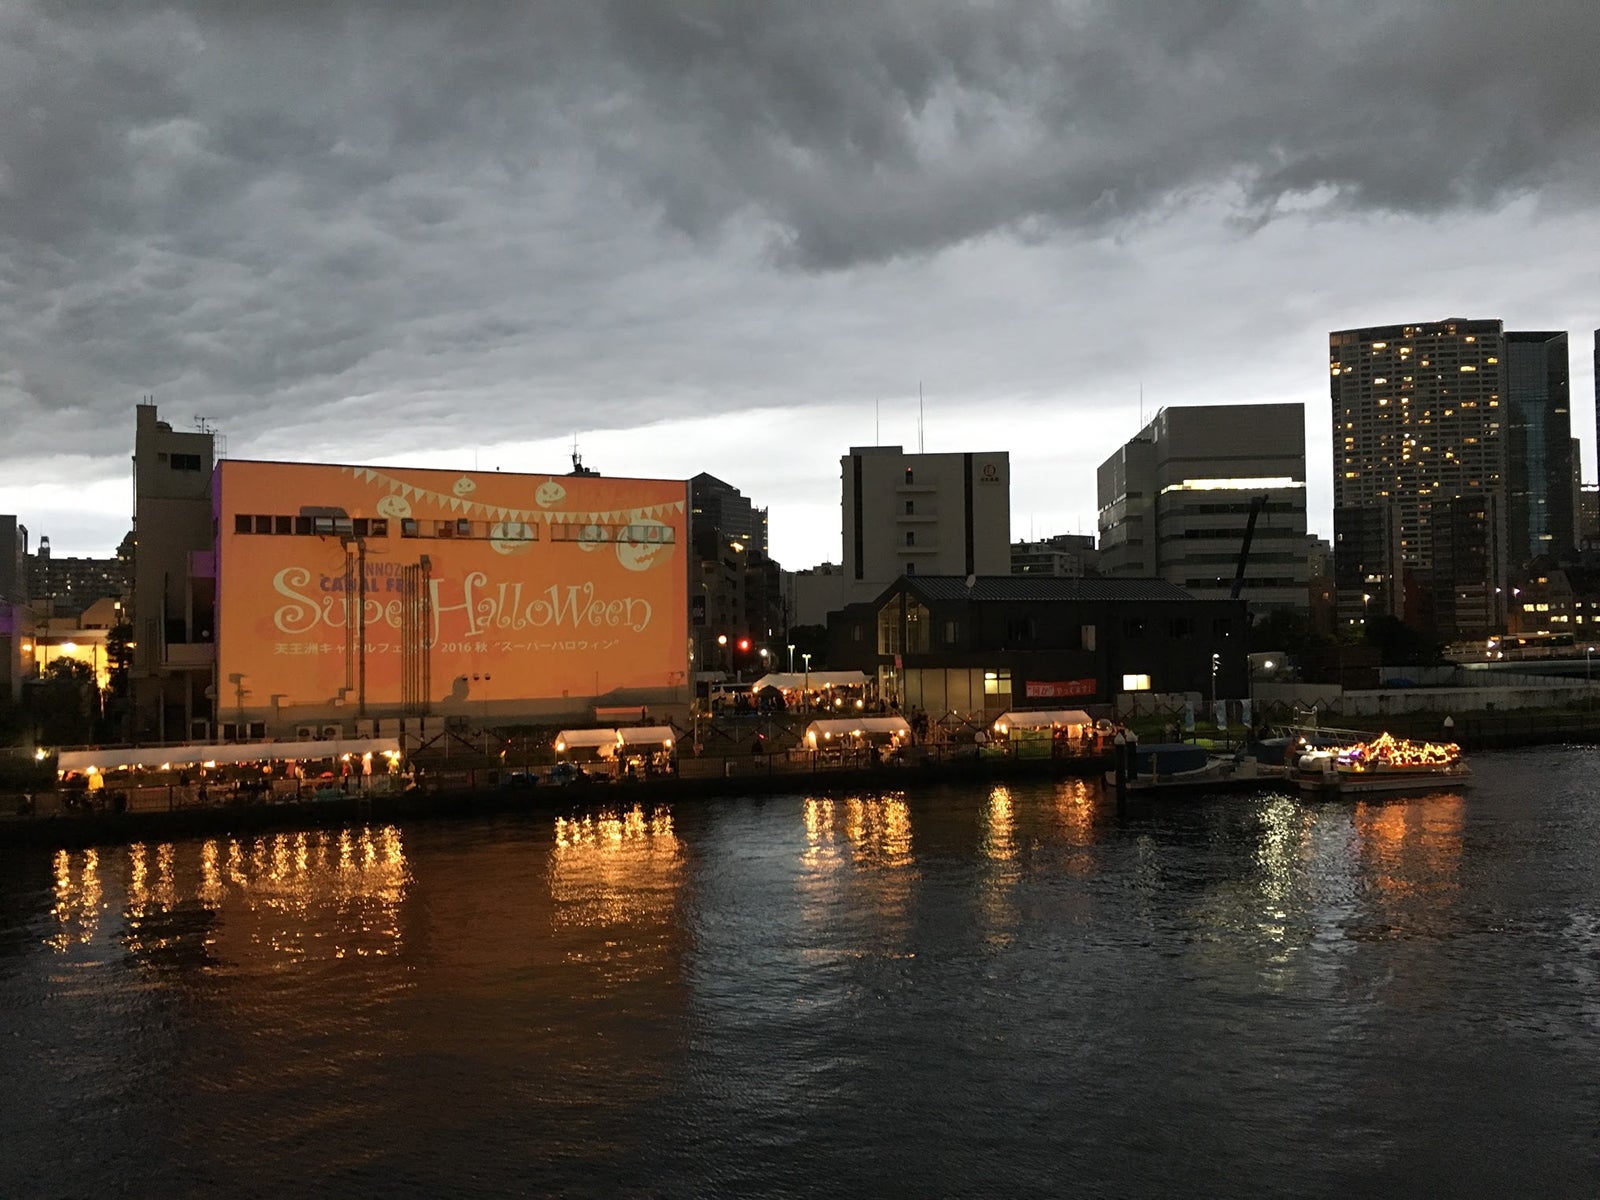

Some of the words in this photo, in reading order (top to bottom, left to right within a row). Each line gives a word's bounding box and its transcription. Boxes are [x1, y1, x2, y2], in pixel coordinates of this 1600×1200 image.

[273, 567, 428, 638] Supe
[441, 642, 471, 653] 2016
[475, 641, 488, 653] 秋
